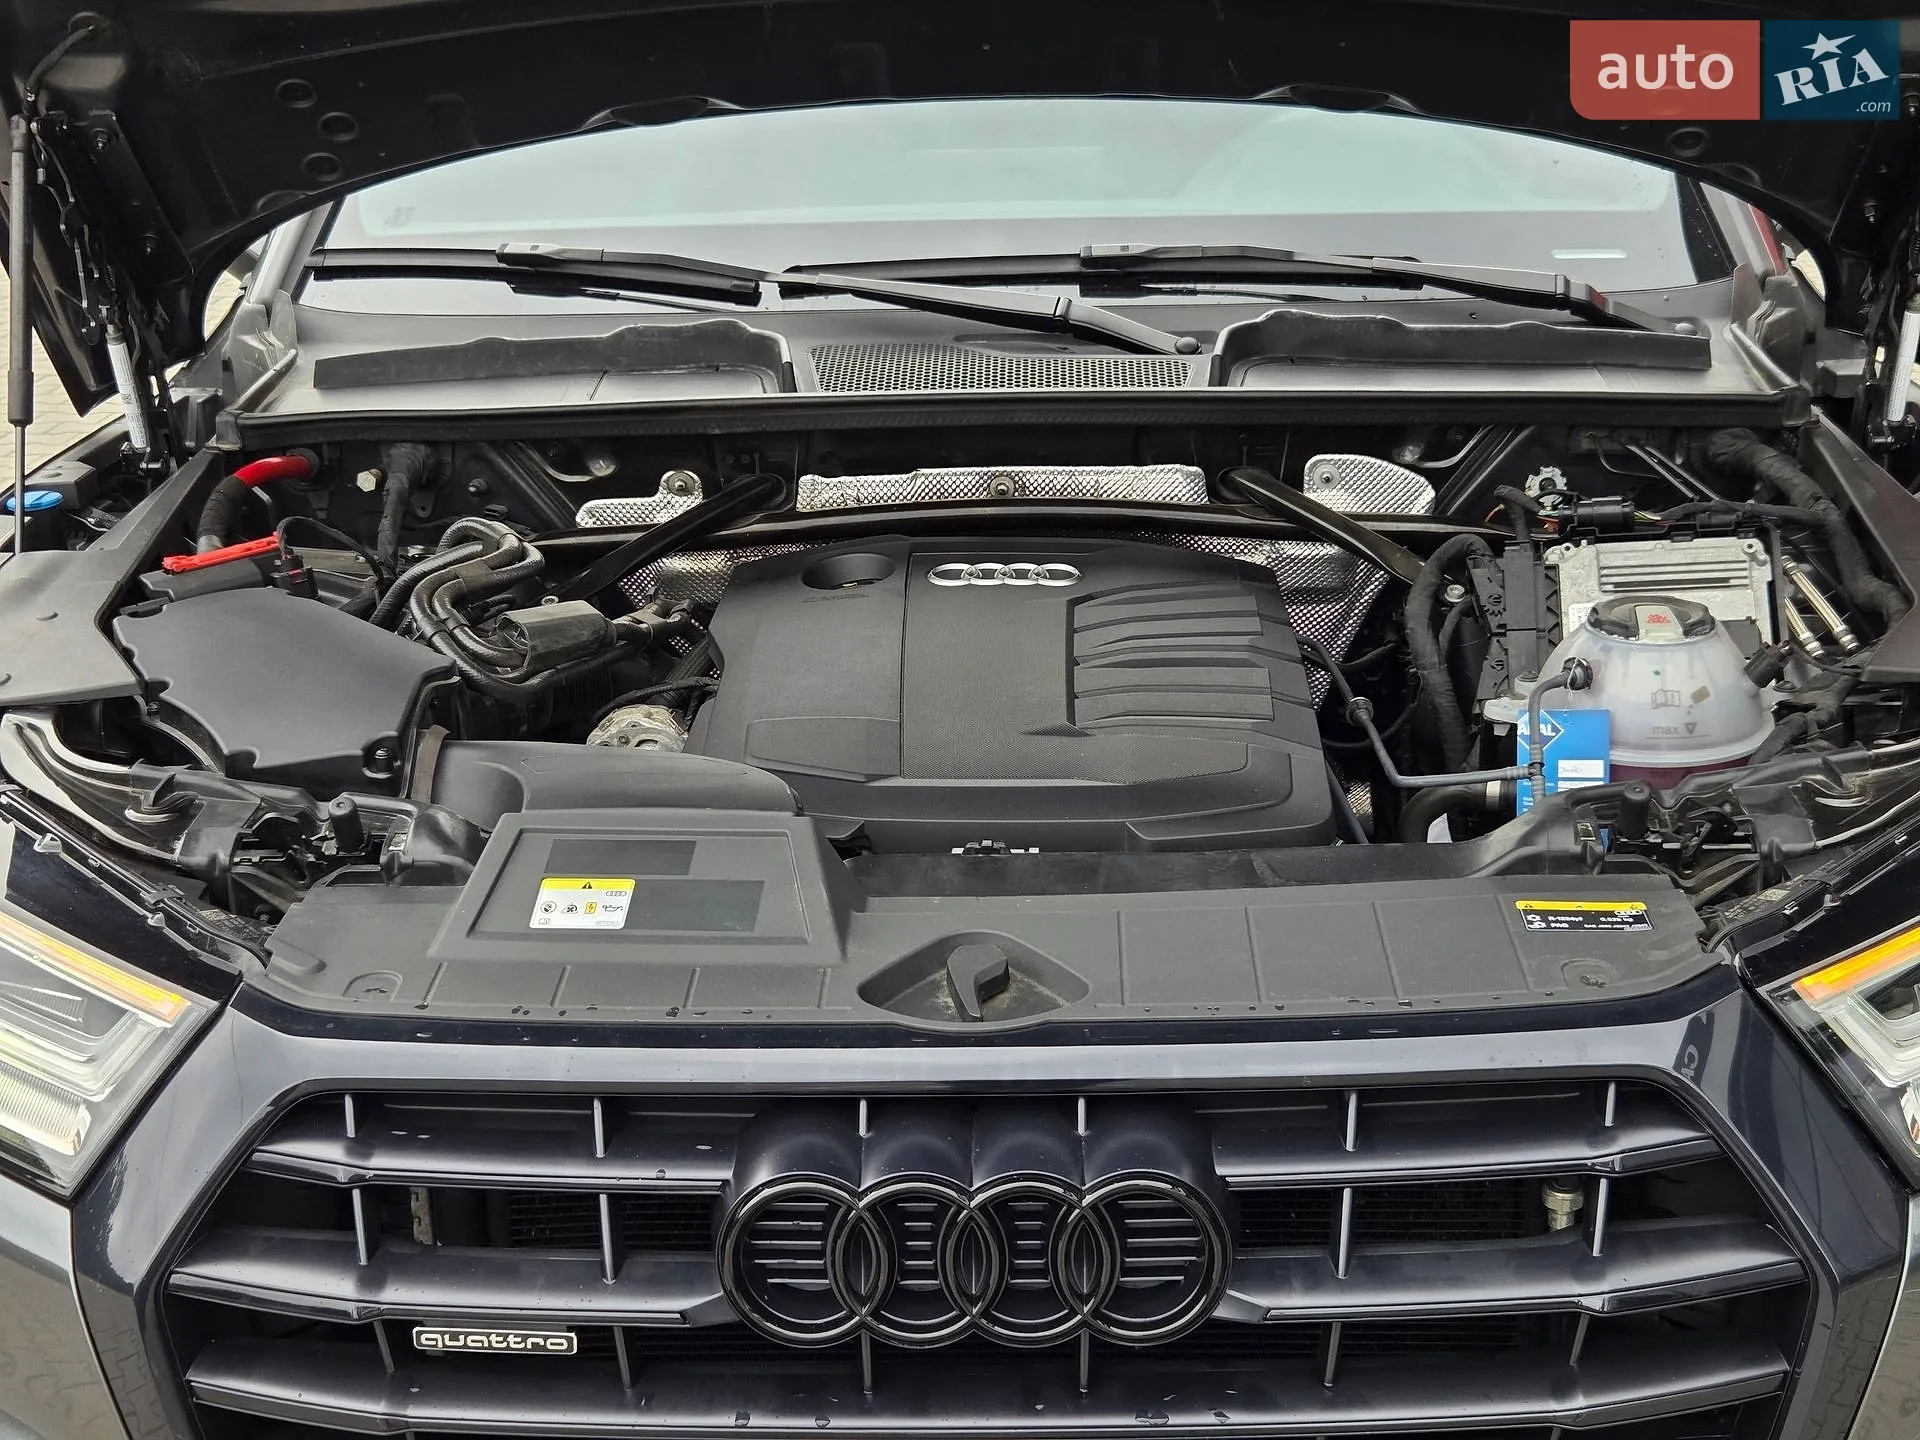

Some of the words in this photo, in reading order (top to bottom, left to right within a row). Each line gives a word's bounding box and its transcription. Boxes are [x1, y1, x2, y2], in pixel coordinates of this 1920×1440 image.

[1517, 723, 1556, 736] AAL
[1652, 726, 1679, 735] max
[420, 1333, 568, 1350] quattro
